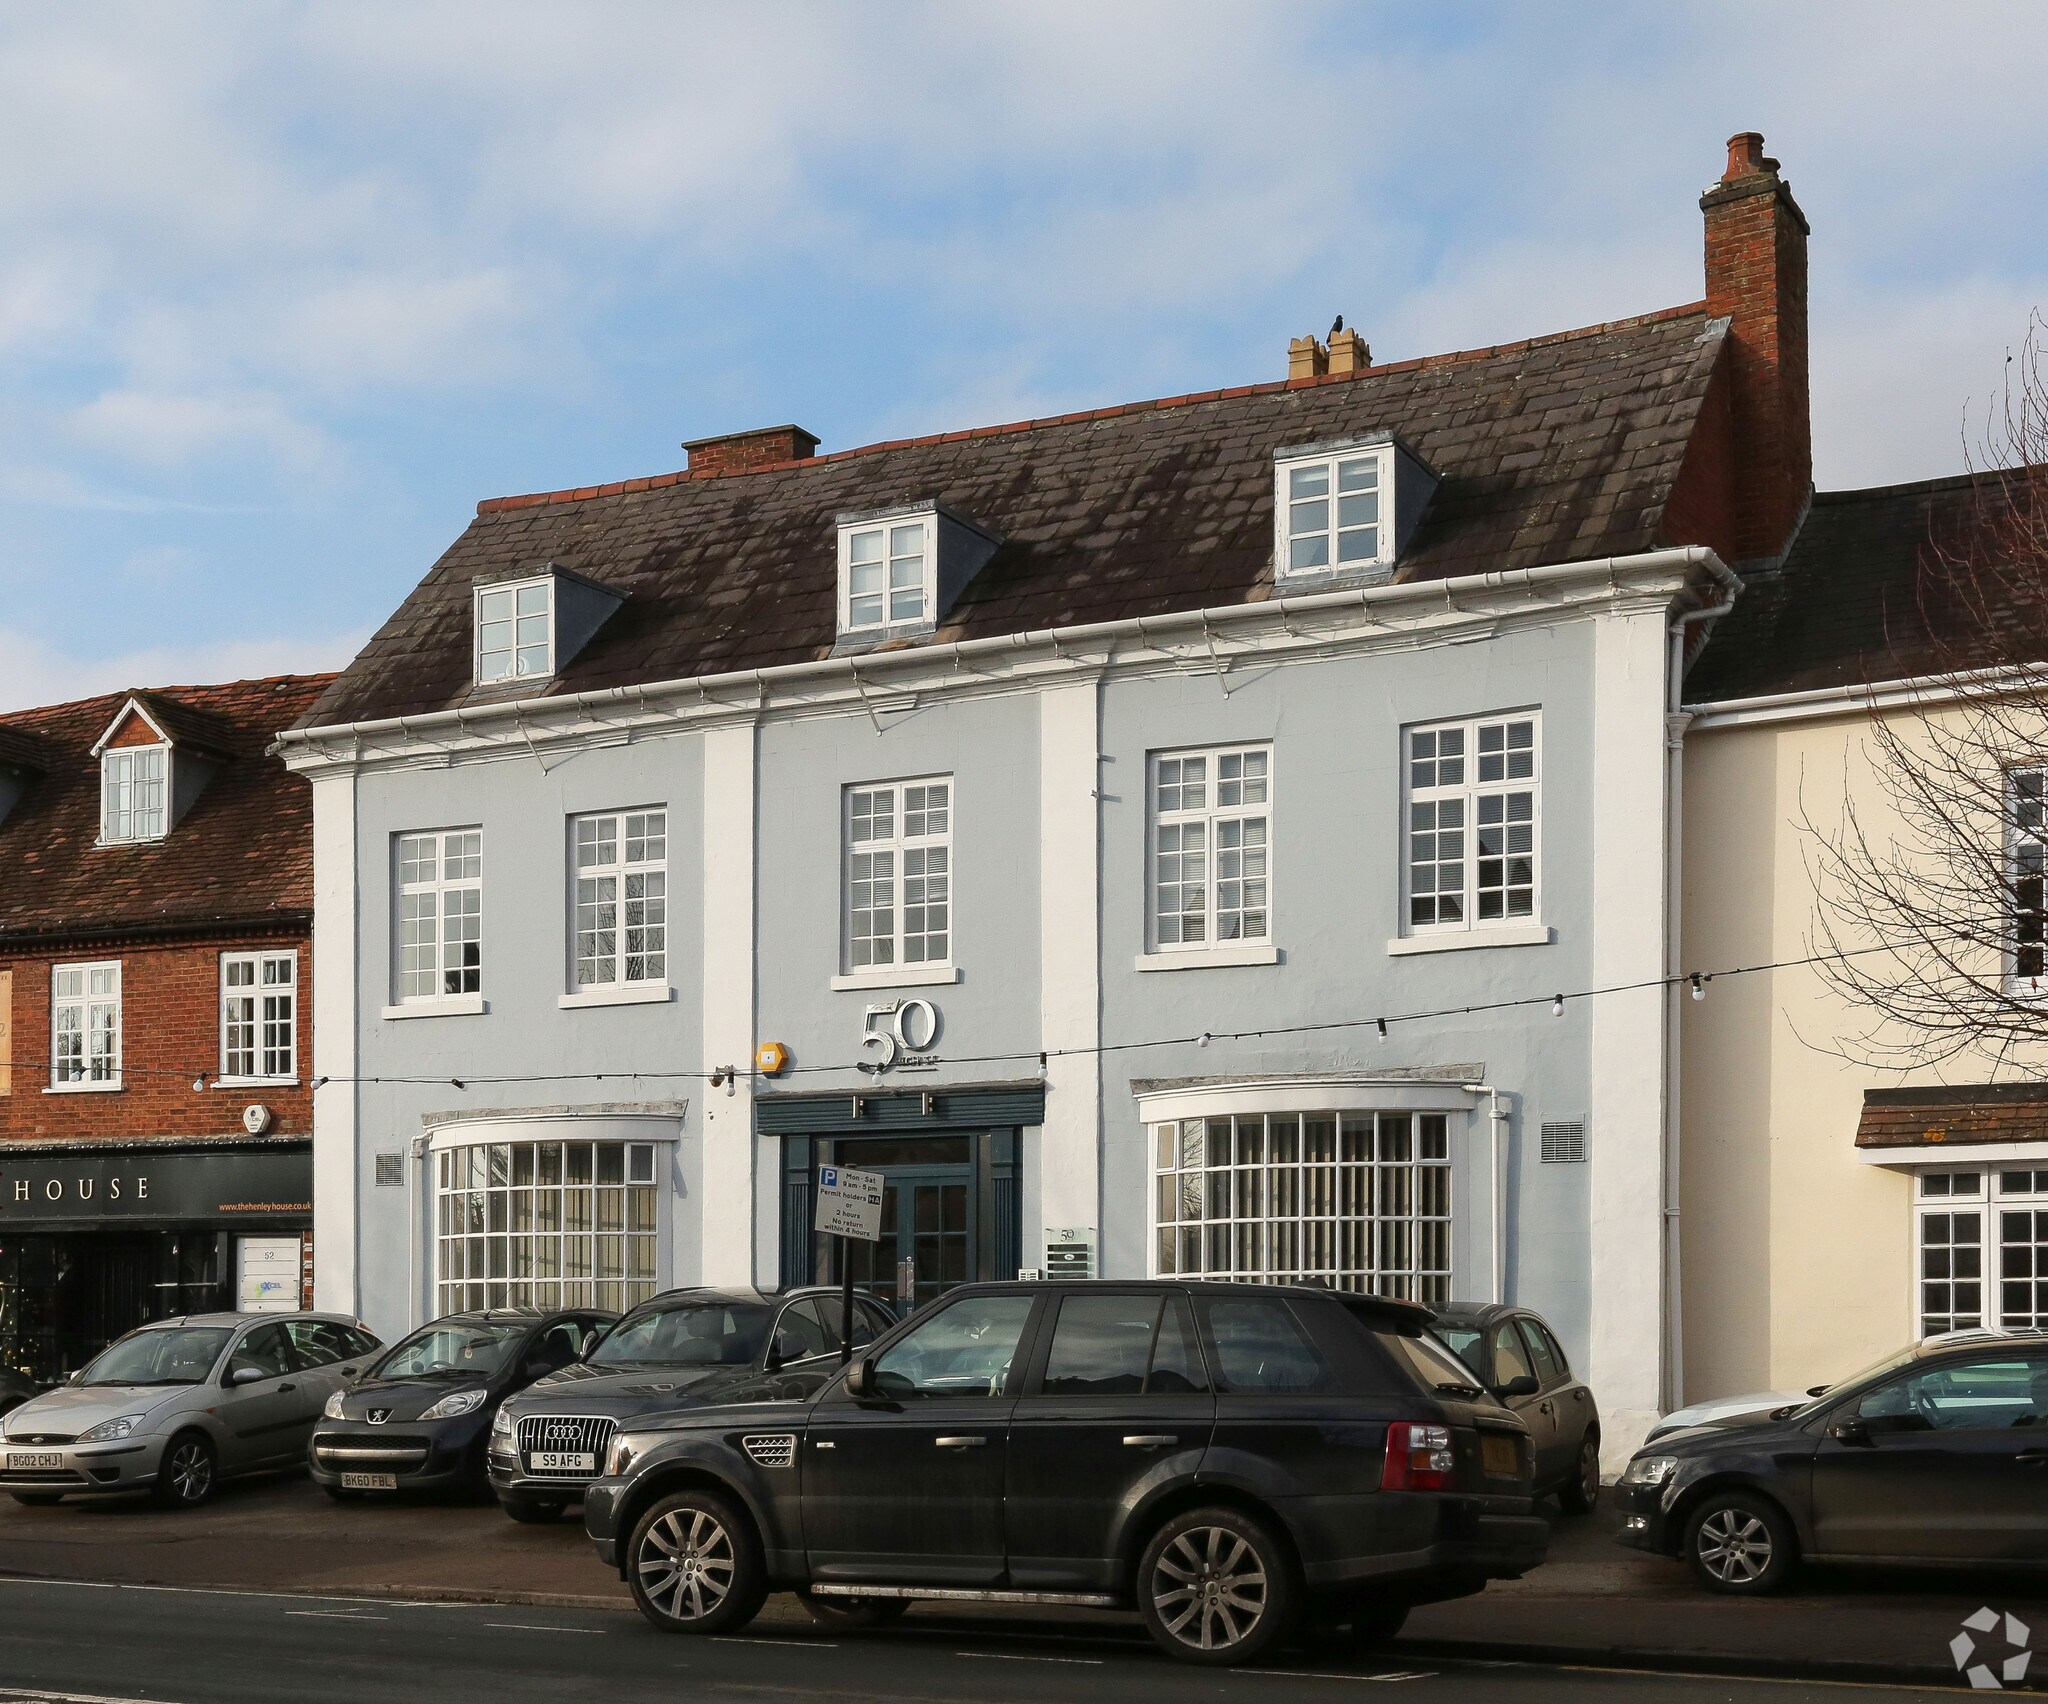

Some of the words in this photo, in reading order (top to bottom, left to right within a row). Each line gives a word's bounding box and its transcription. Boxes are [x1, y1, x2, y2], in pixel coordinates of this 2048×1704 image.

[857, 998, 937, 1075] 50
[825, 1170, 835, 1184] P
[14, 1177, 149, 1201] HOUSE
[820, 1188, 841, 1196] Permit
[843, 1192, 866, 1201] holders
[869, 1196, 880, 1204] HA
[218, 1201, 312, 1212] www.thehenleyhouse.co.uk
[843, 1220, 863, 1228] return
[1060, 1229, 1075, 1242] 50
[264, 1251, 275, 1260] 52
[260, 1281, 282, 1290] EXCEL
[13, 1455, 37, 1467] BG02
[38, 1455, 58, 1467] CHJ
[542, 1454, 557, 1467] S9
[560, 1454, 582, 1467] AFG
[345, 1474, 370, 1487] BK60
